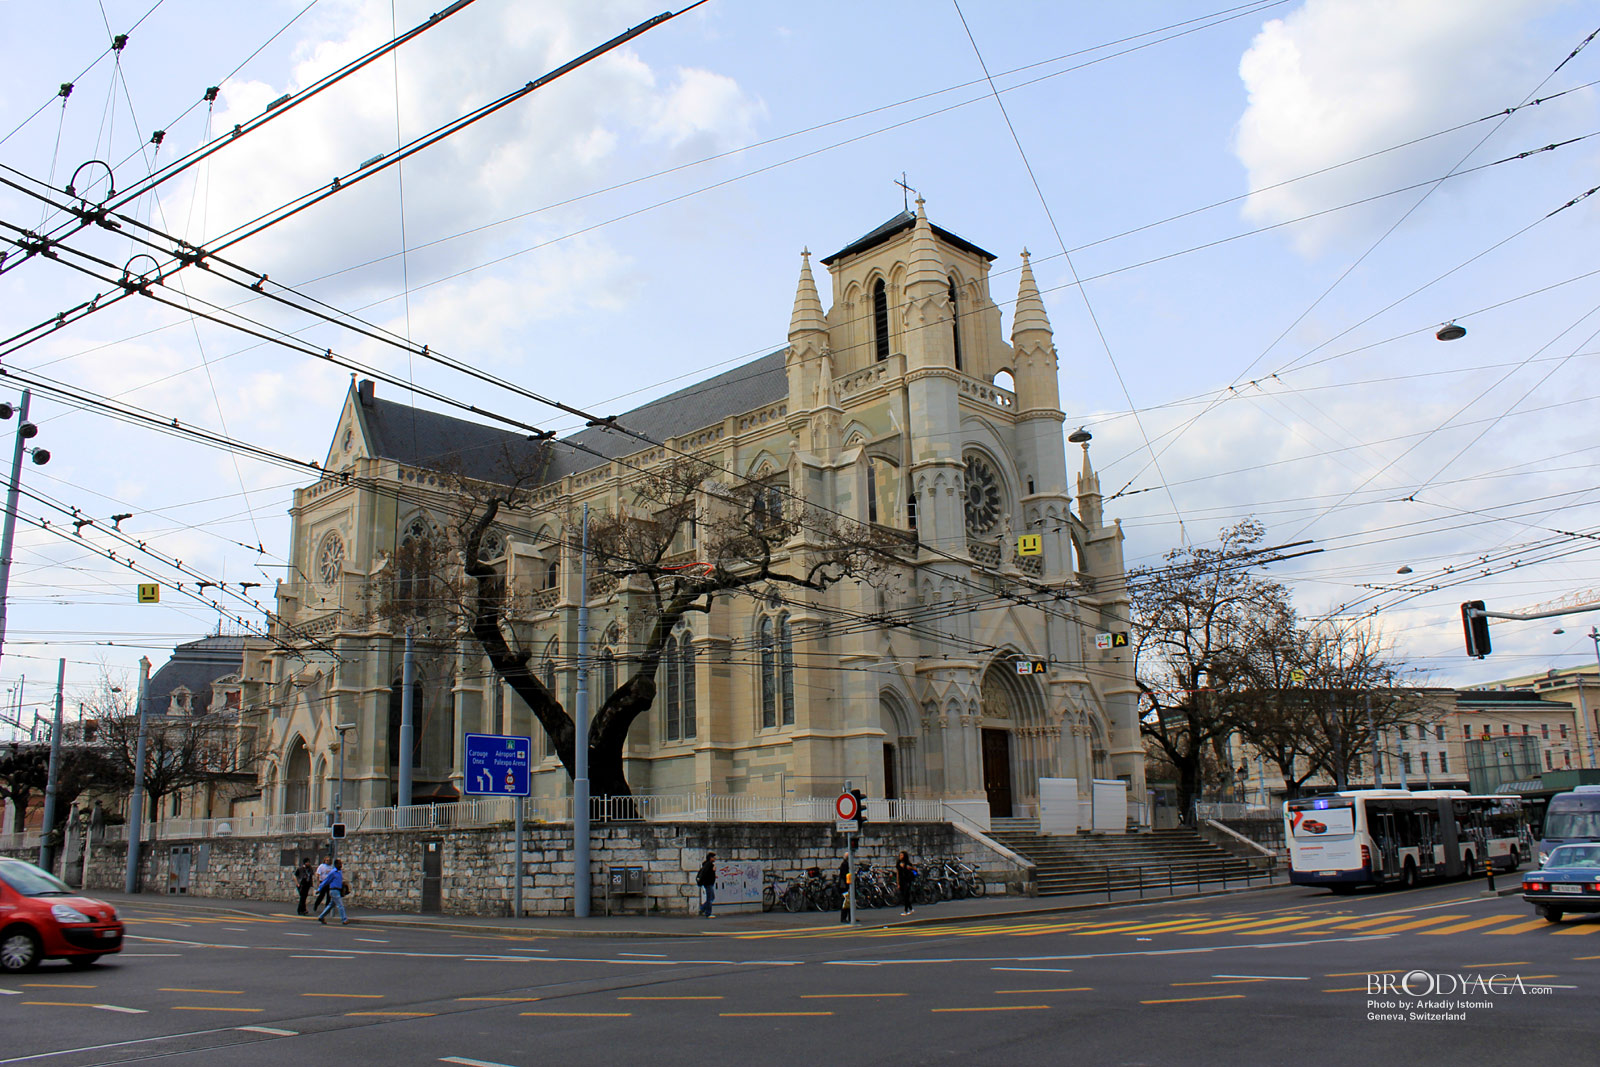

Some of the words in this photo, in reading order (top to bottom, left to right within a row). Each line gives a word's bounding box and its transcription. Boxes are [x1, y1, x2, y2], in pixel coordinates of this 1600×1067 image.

[1116, 633, 1126, 645] A
[1035, 662, 1044, 673] A
[469, 750, 488, 758] Carouge
[612, 874, 622, 883] 20
[631, 870, 639, 879] 20
